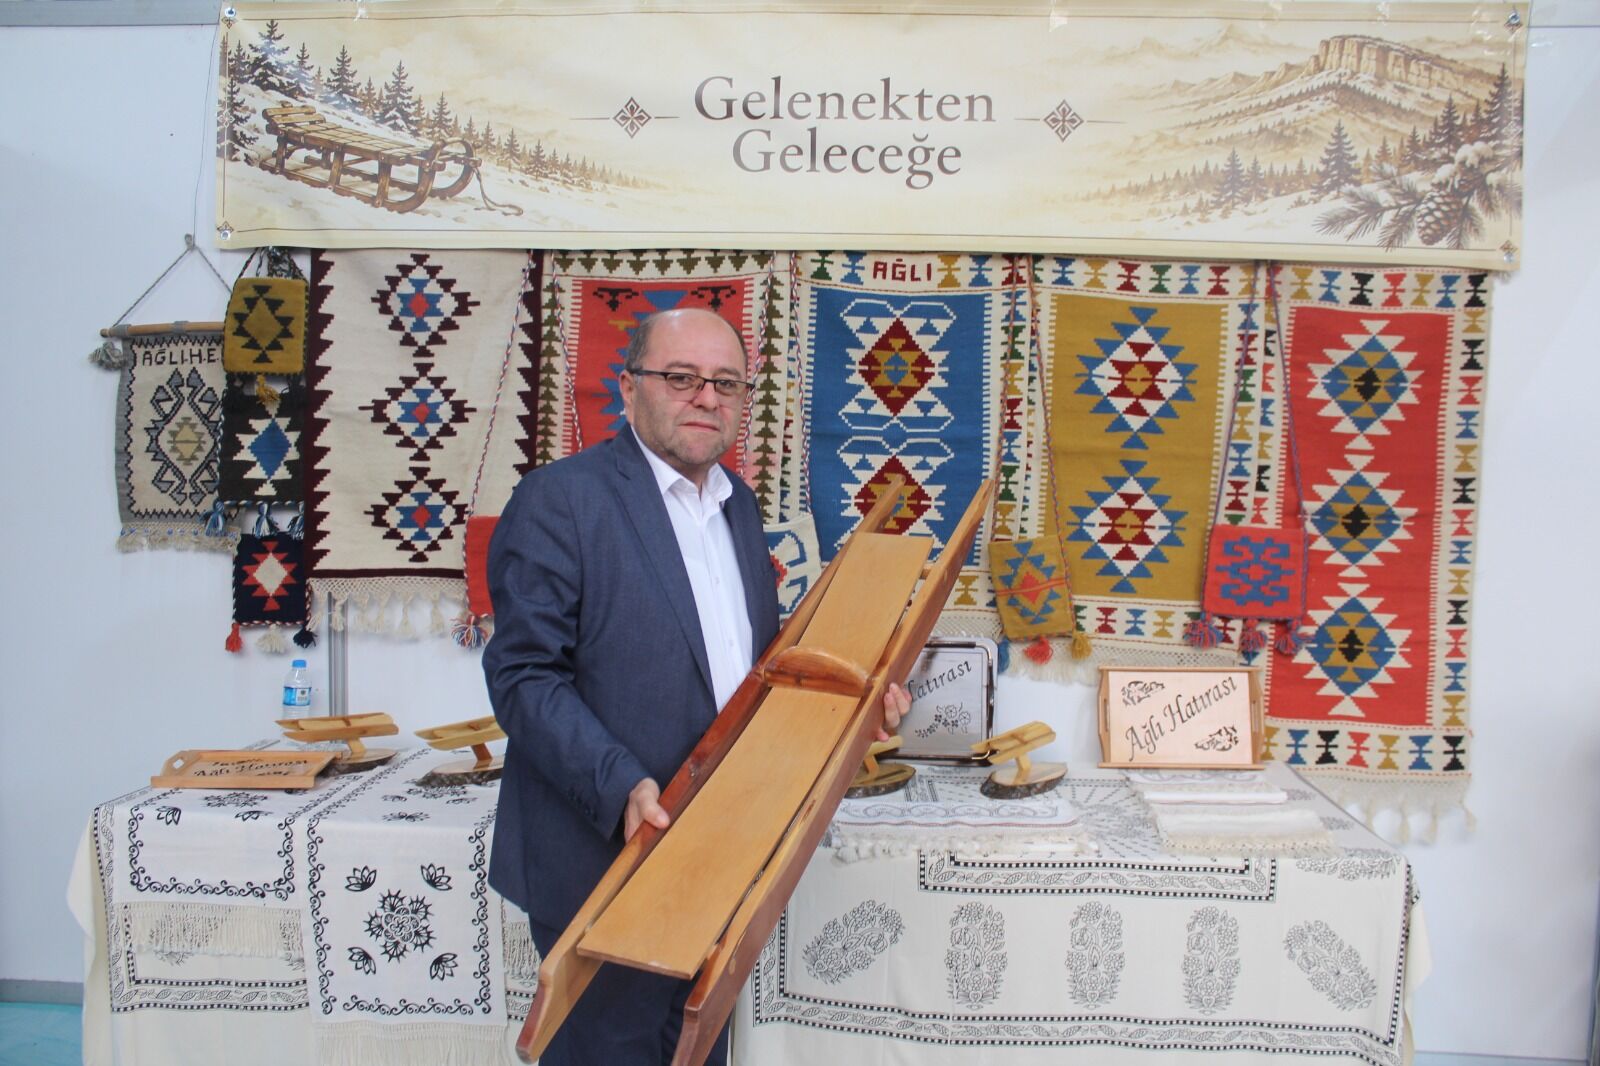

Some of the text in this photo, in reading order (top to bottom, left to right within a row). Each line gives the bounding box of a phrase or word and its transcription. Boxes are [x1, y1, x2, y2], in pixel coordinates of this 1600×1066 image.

[694, 75, 997, 122] Gelenekten
[732, 126, 962, 190] Geleceğe
[873, 258, 932, 282] AĞLI
[1125, 676, 1238, 762] Ağlı Hatırası
